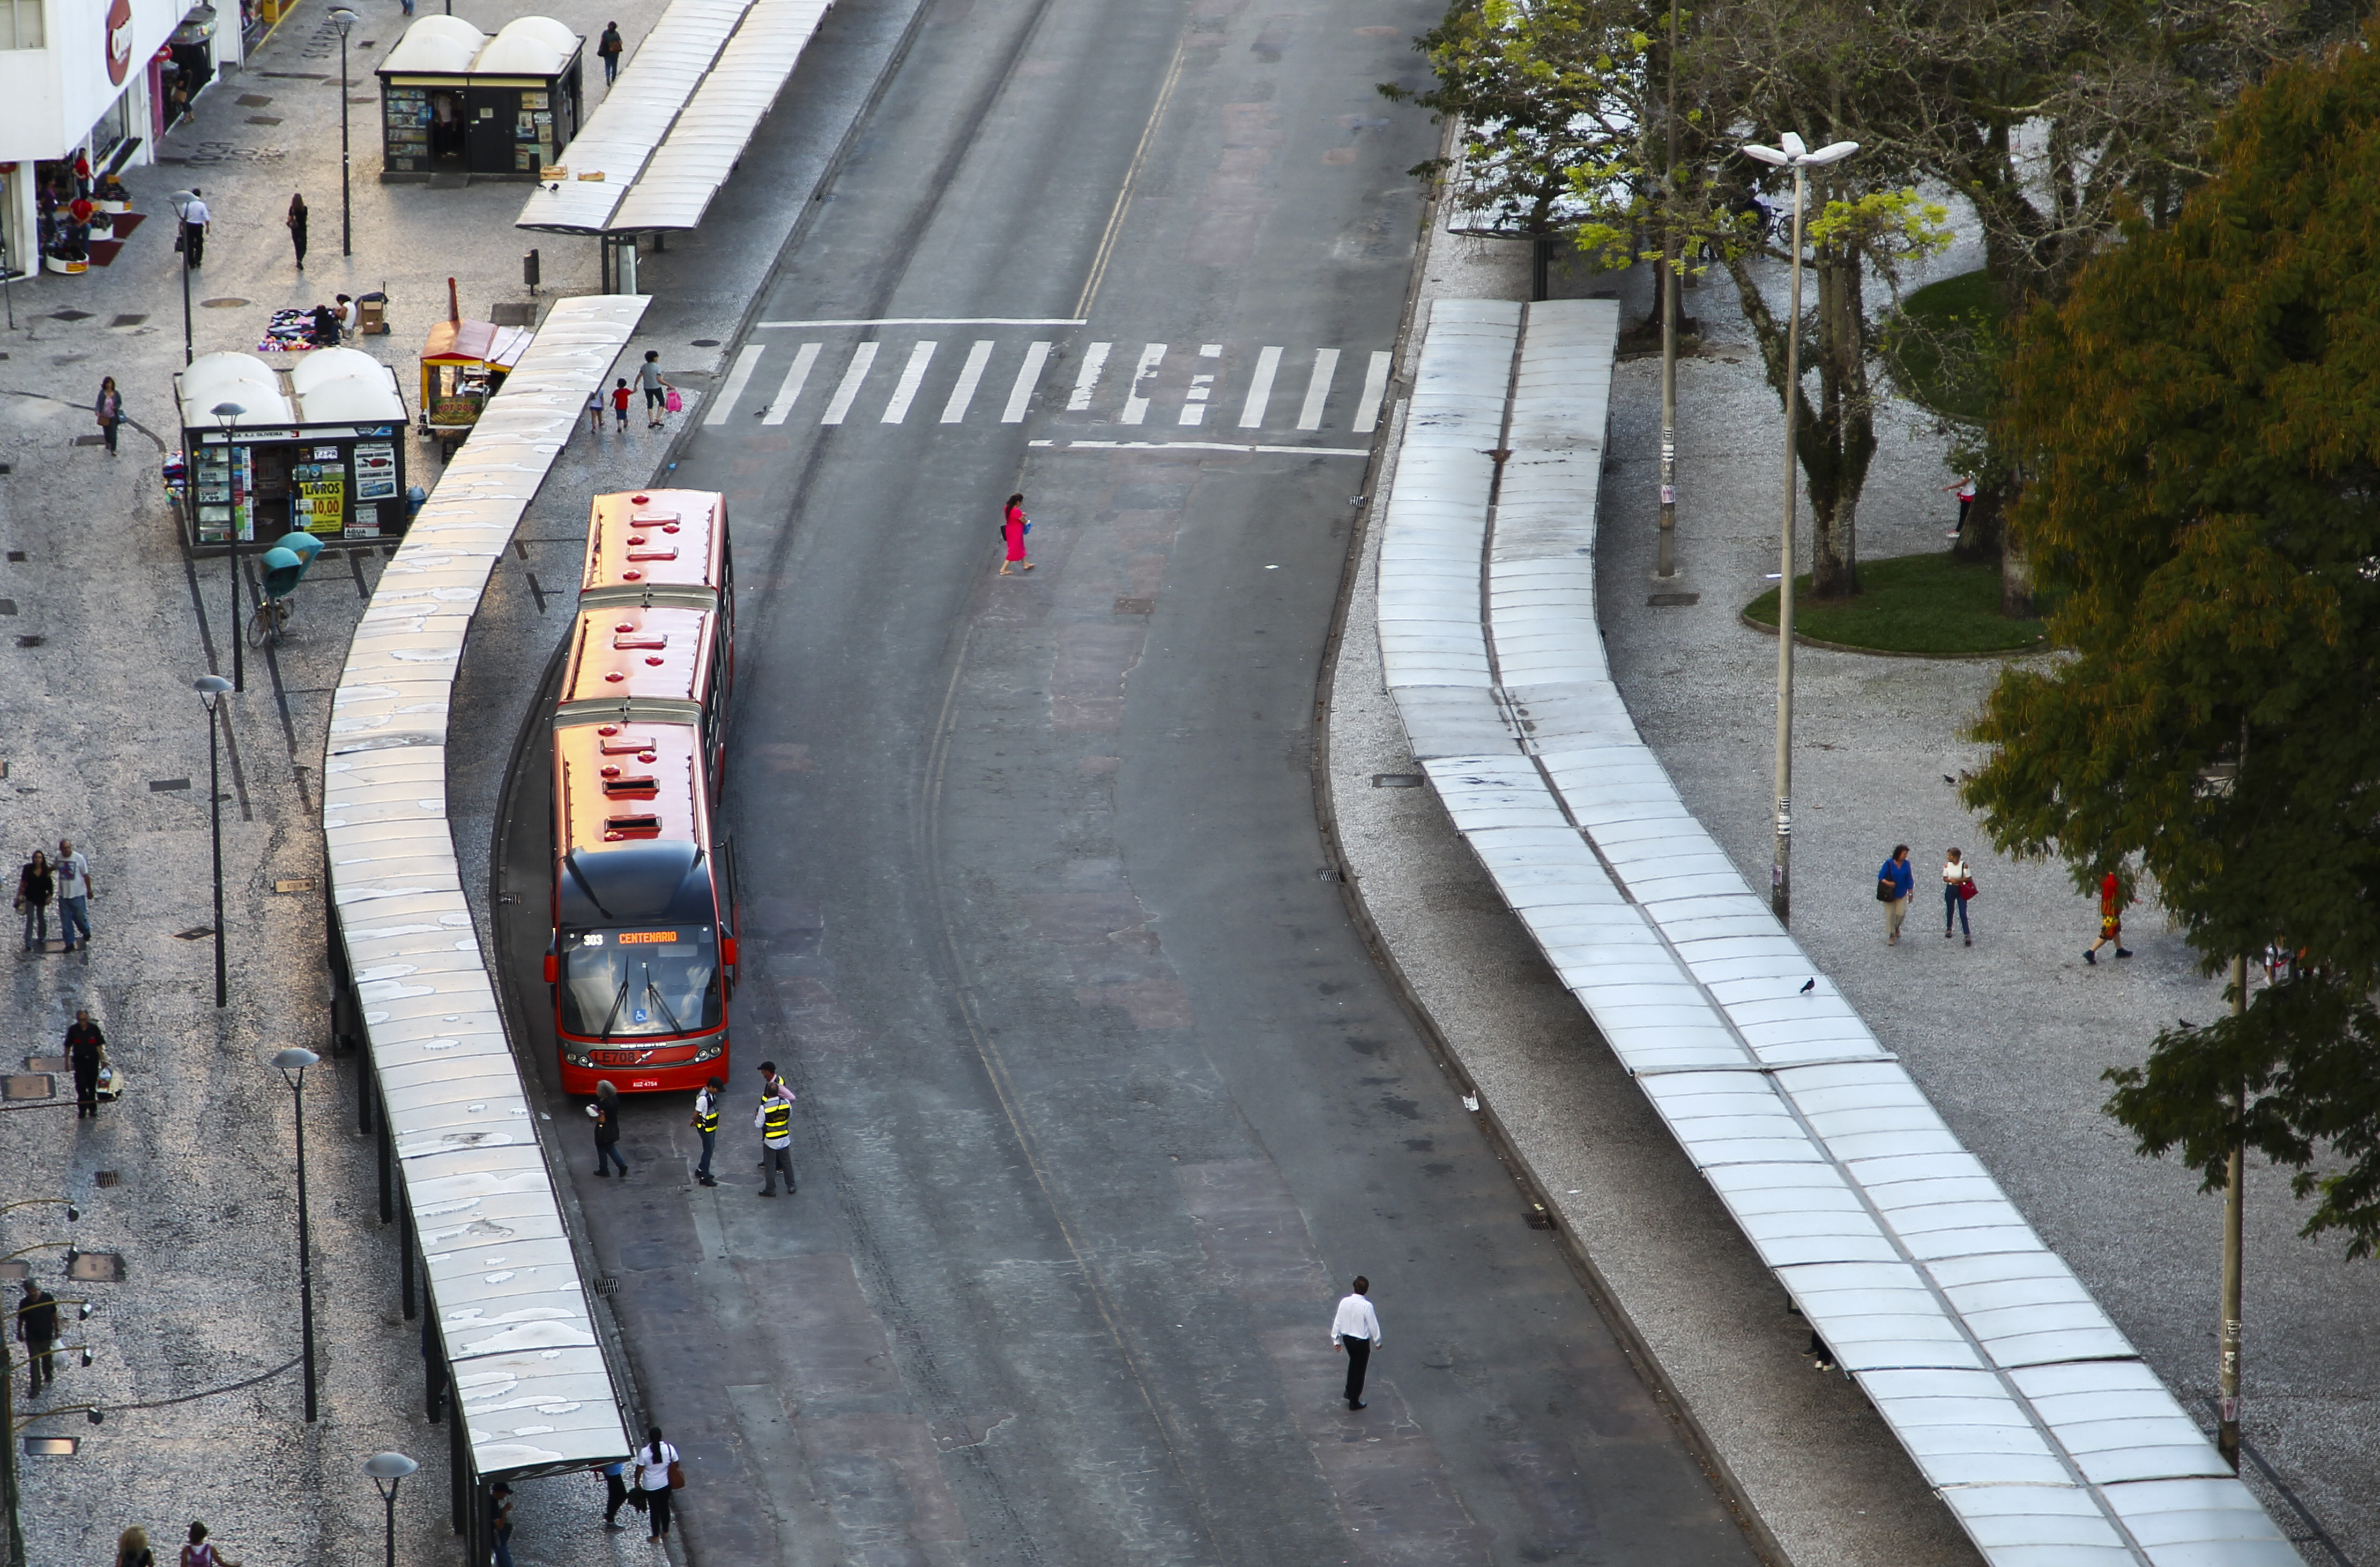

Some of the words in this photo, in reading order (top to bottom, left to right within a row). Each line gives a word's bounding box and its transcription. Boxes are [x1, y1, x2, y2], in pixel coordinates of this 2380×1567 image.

[438, 404, 455, 412] HOT
[306, 483, 339, 495] LIVROS
[313, 499, 339, 516] 10,00
[583, 934, 604, 946] 303
[619, 931, 677, 944] CENTENARIO
[594, 1051, 635, 1063] LE708
